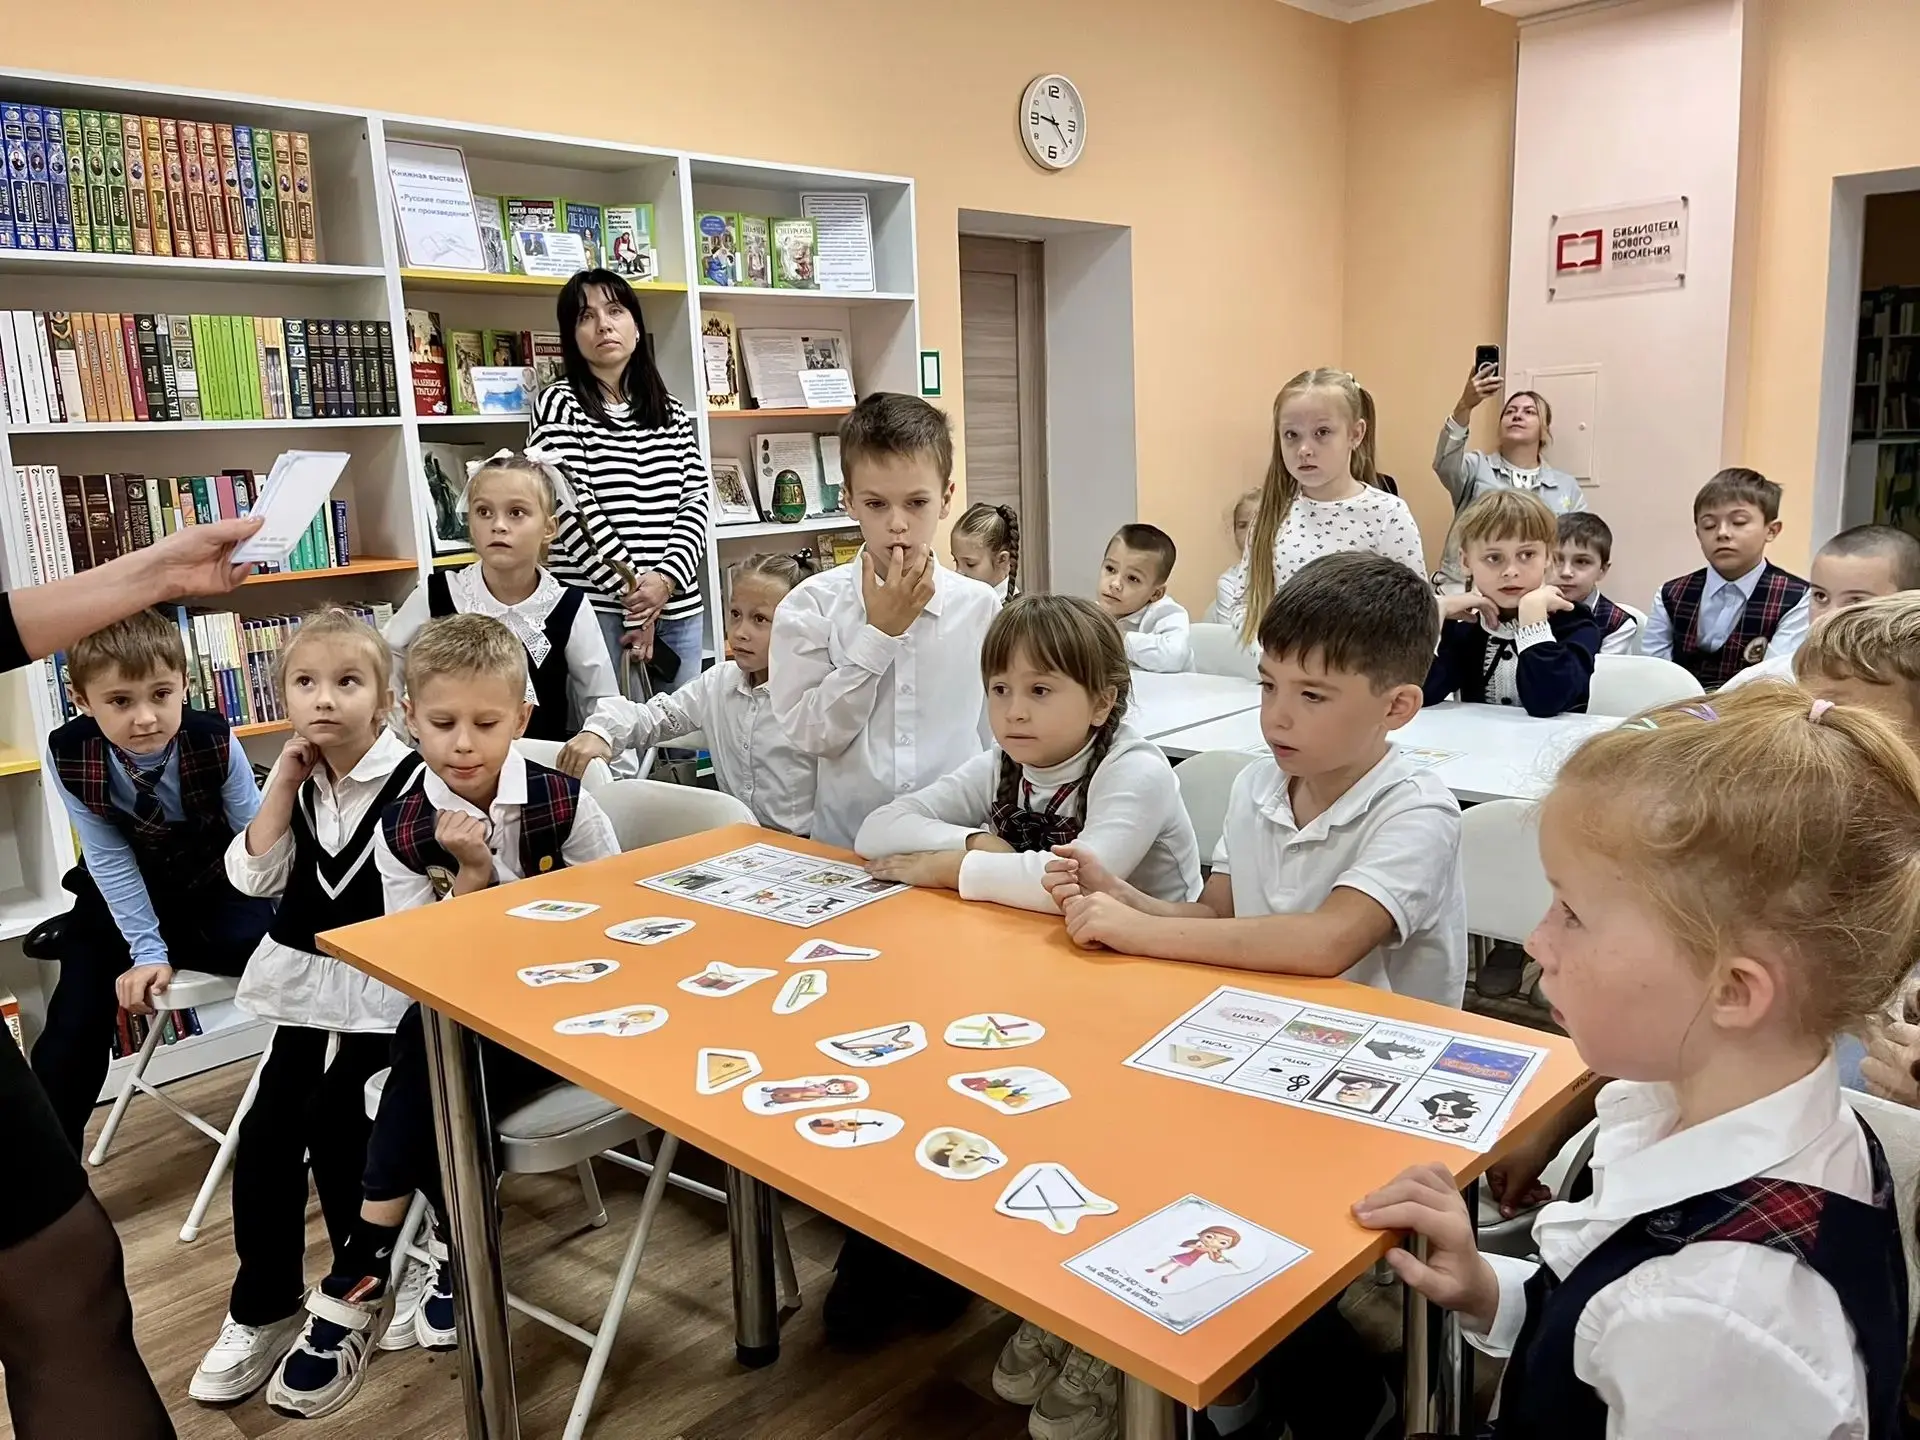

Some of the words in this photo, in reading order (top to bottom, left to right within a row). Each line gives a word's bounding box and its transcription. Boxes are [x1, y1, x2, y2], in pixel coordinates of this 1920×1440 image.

[1048, 85, 1060, 98] 12
[1030, 111, 1040, 125] 9
[1067, 120, 1076, 133] 3
[1047, 145, 1058, 159] 6
[391, 169, 427, 179] Книжная
[429, 175, 464, 184] выставка
[567, 212, 601, 229] ЛЕВША
[1612, 220, 1678, 238] БИБЛИОТЕКА
[1612, 235, 1652, 249] НОВОГО
[1611, 245, 1670, 261] ПОКОЛЕНИЯ
[163, 364, 176, 398] БУНИН
[170, 399, 180, 417] И.А.
[21, 492, 31, 521] ДЕТСТВА
[37, 491, 46, 520] ДЕТСТВА
[52, 491, 60, 520] ДЕТСТВА
[25, 524, 35, 553] НАШЕГО
[42, 523, 51, 552] НАШЕГО
[56, 523, 65, 551] НАШЕГО
[1232, 1012, 1265, 1024] ТЕМП
[1201, 1039, 1233, 1049] ГУСЛИ
[1282, 1056, 1311, 1067] НОТЫ
